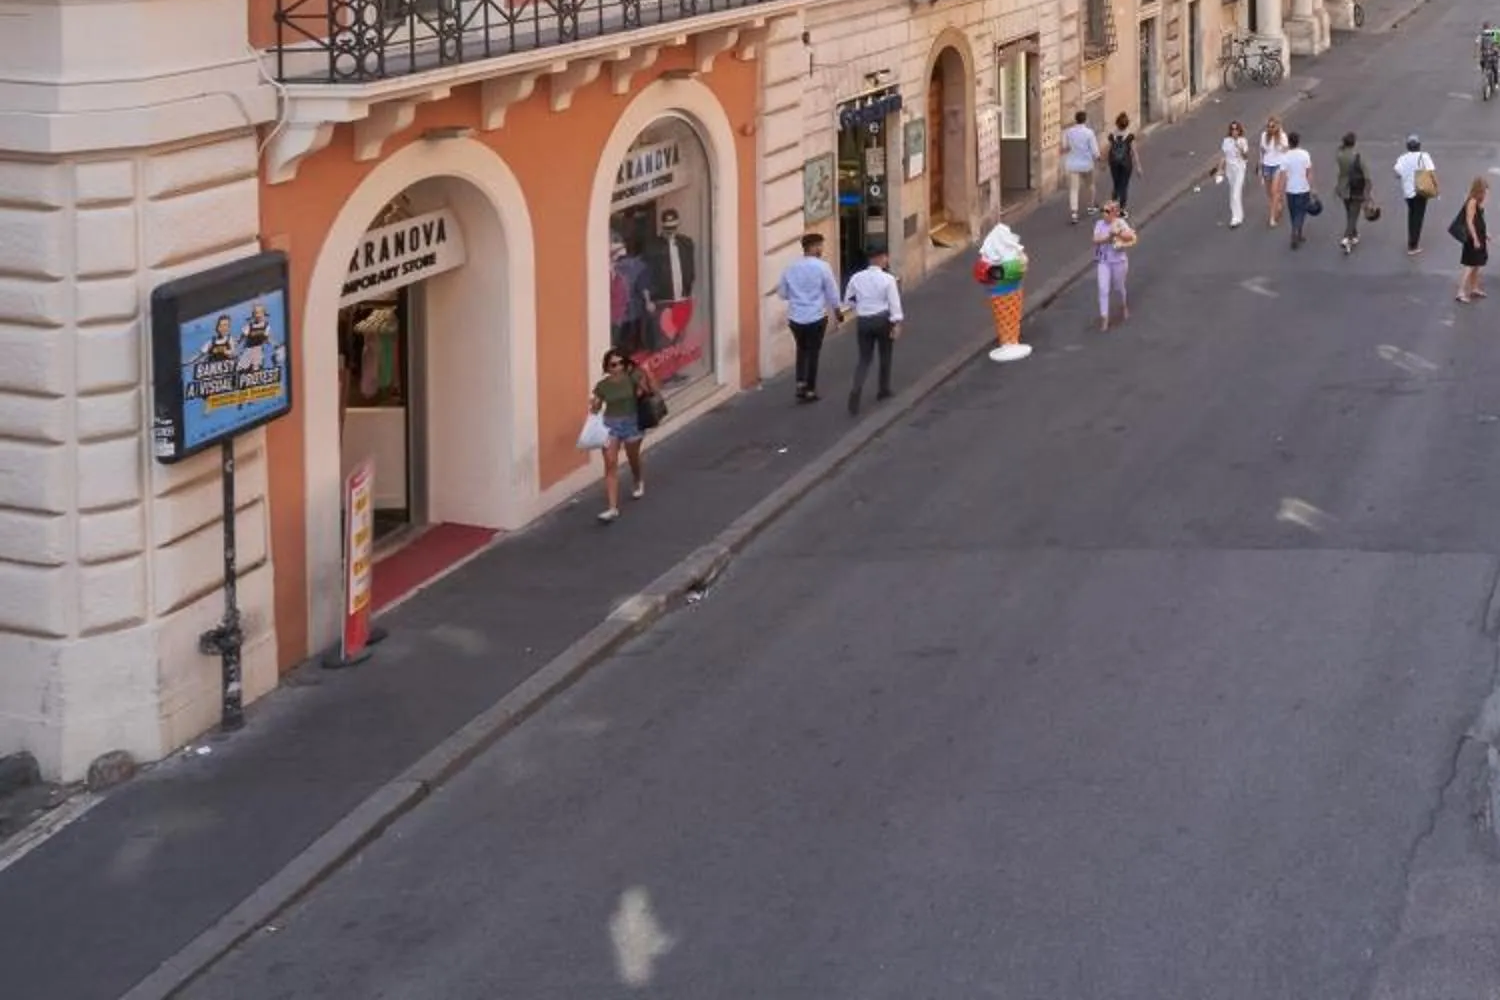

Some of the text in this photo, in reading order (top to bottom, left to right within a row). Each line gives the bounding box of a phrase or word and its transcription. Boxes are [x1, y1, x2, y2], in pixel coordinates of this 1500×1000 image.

[402, 251, 437, 276] STORE
[196, 359, 236, 380] BANKSY
[199, 376, 233, 397] VISUAL
[239, 366, 281, 390] PROTEST
